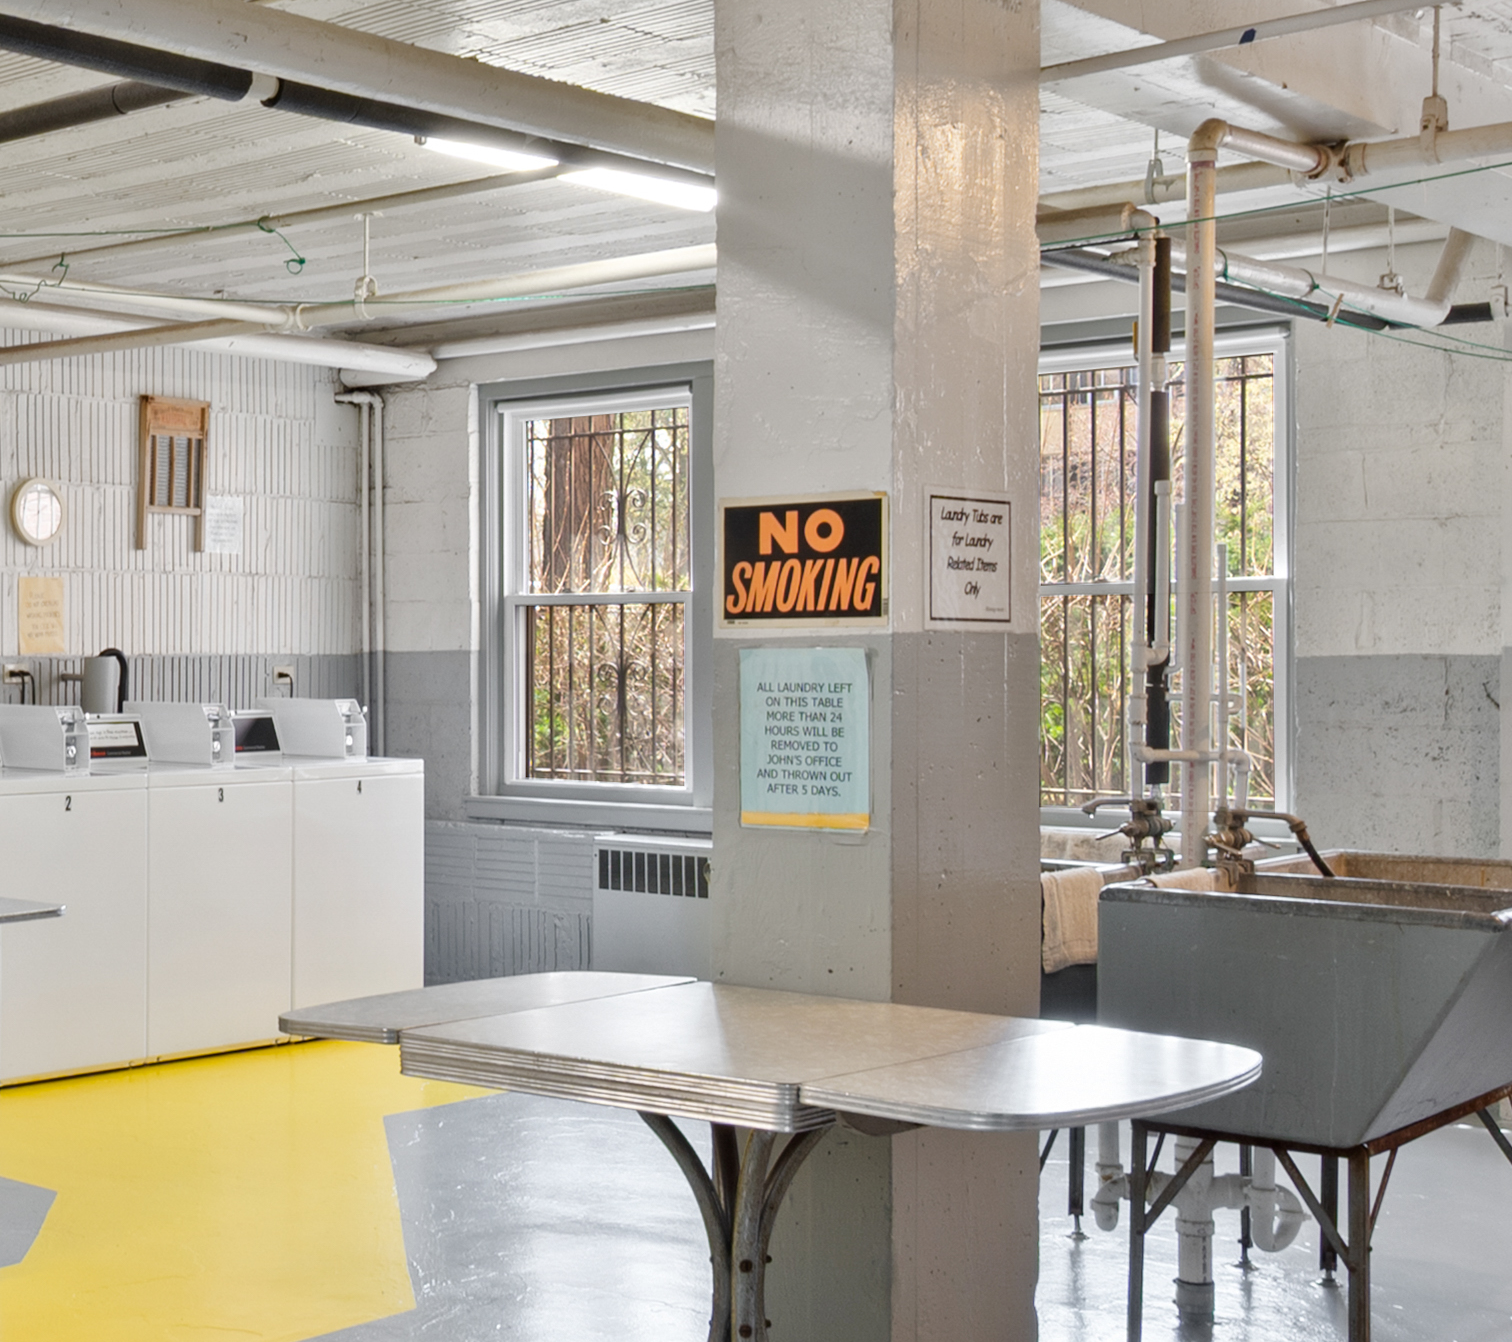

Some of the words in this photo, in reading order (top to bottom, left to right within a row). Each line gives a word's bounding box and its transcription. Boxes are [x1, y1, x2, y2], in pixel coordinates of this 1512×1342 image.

[940, 506, 970, 527] Laundry
[972, 508, 989, 524] Tubs
[990, 514, 1003, 525] are
[759, 508, 845, 555] NO
[951, 531, 964, 547] for
[965, 532, 994, 552] Laundry
[947, 555, 975, 572] Related
[976, 557, 998, 573] Items
[726, 554, 880, 614] SMOKING
[964, 581, 982, 600] Only
[757, 682, 775, 693] ALL
[777, 682, 825, 694] LAUNDRY
[828, 683, 853, 694] LEFT
[765, 696, 780, 707] ON
[783, 696, 808, 708] THIS
[811, 697, 844, 708] TABLE
[766, 710, 795, 722] MORE
[798, 711, 827, 722] THAN
[830, 712, 842, 723] 24
[764, 725, 799, 736] HOURS
[802, 726, 828, 737] WILL
[831, 727, 845, 738] BE
[770, 739, 820, 751] REMOVED
[823, 741, 838, 752] TO
[767, 754, 802, 766] JOHN'S
[804, 755, 842, 767] OFFICE
[756, 768, 778, 779] AND
[781, 769, 827, 781] THROWN
[830, 771, 853, 782] OUT
[218, 787, 225, 803] 3
[357, 780, 362, 795] 4
[767, 783, 798, 795] AFTER
[802, 784, 808, 795] 5
[811, 785, 842, 797] DAYS.
[65, 795, 72, 812] 2
